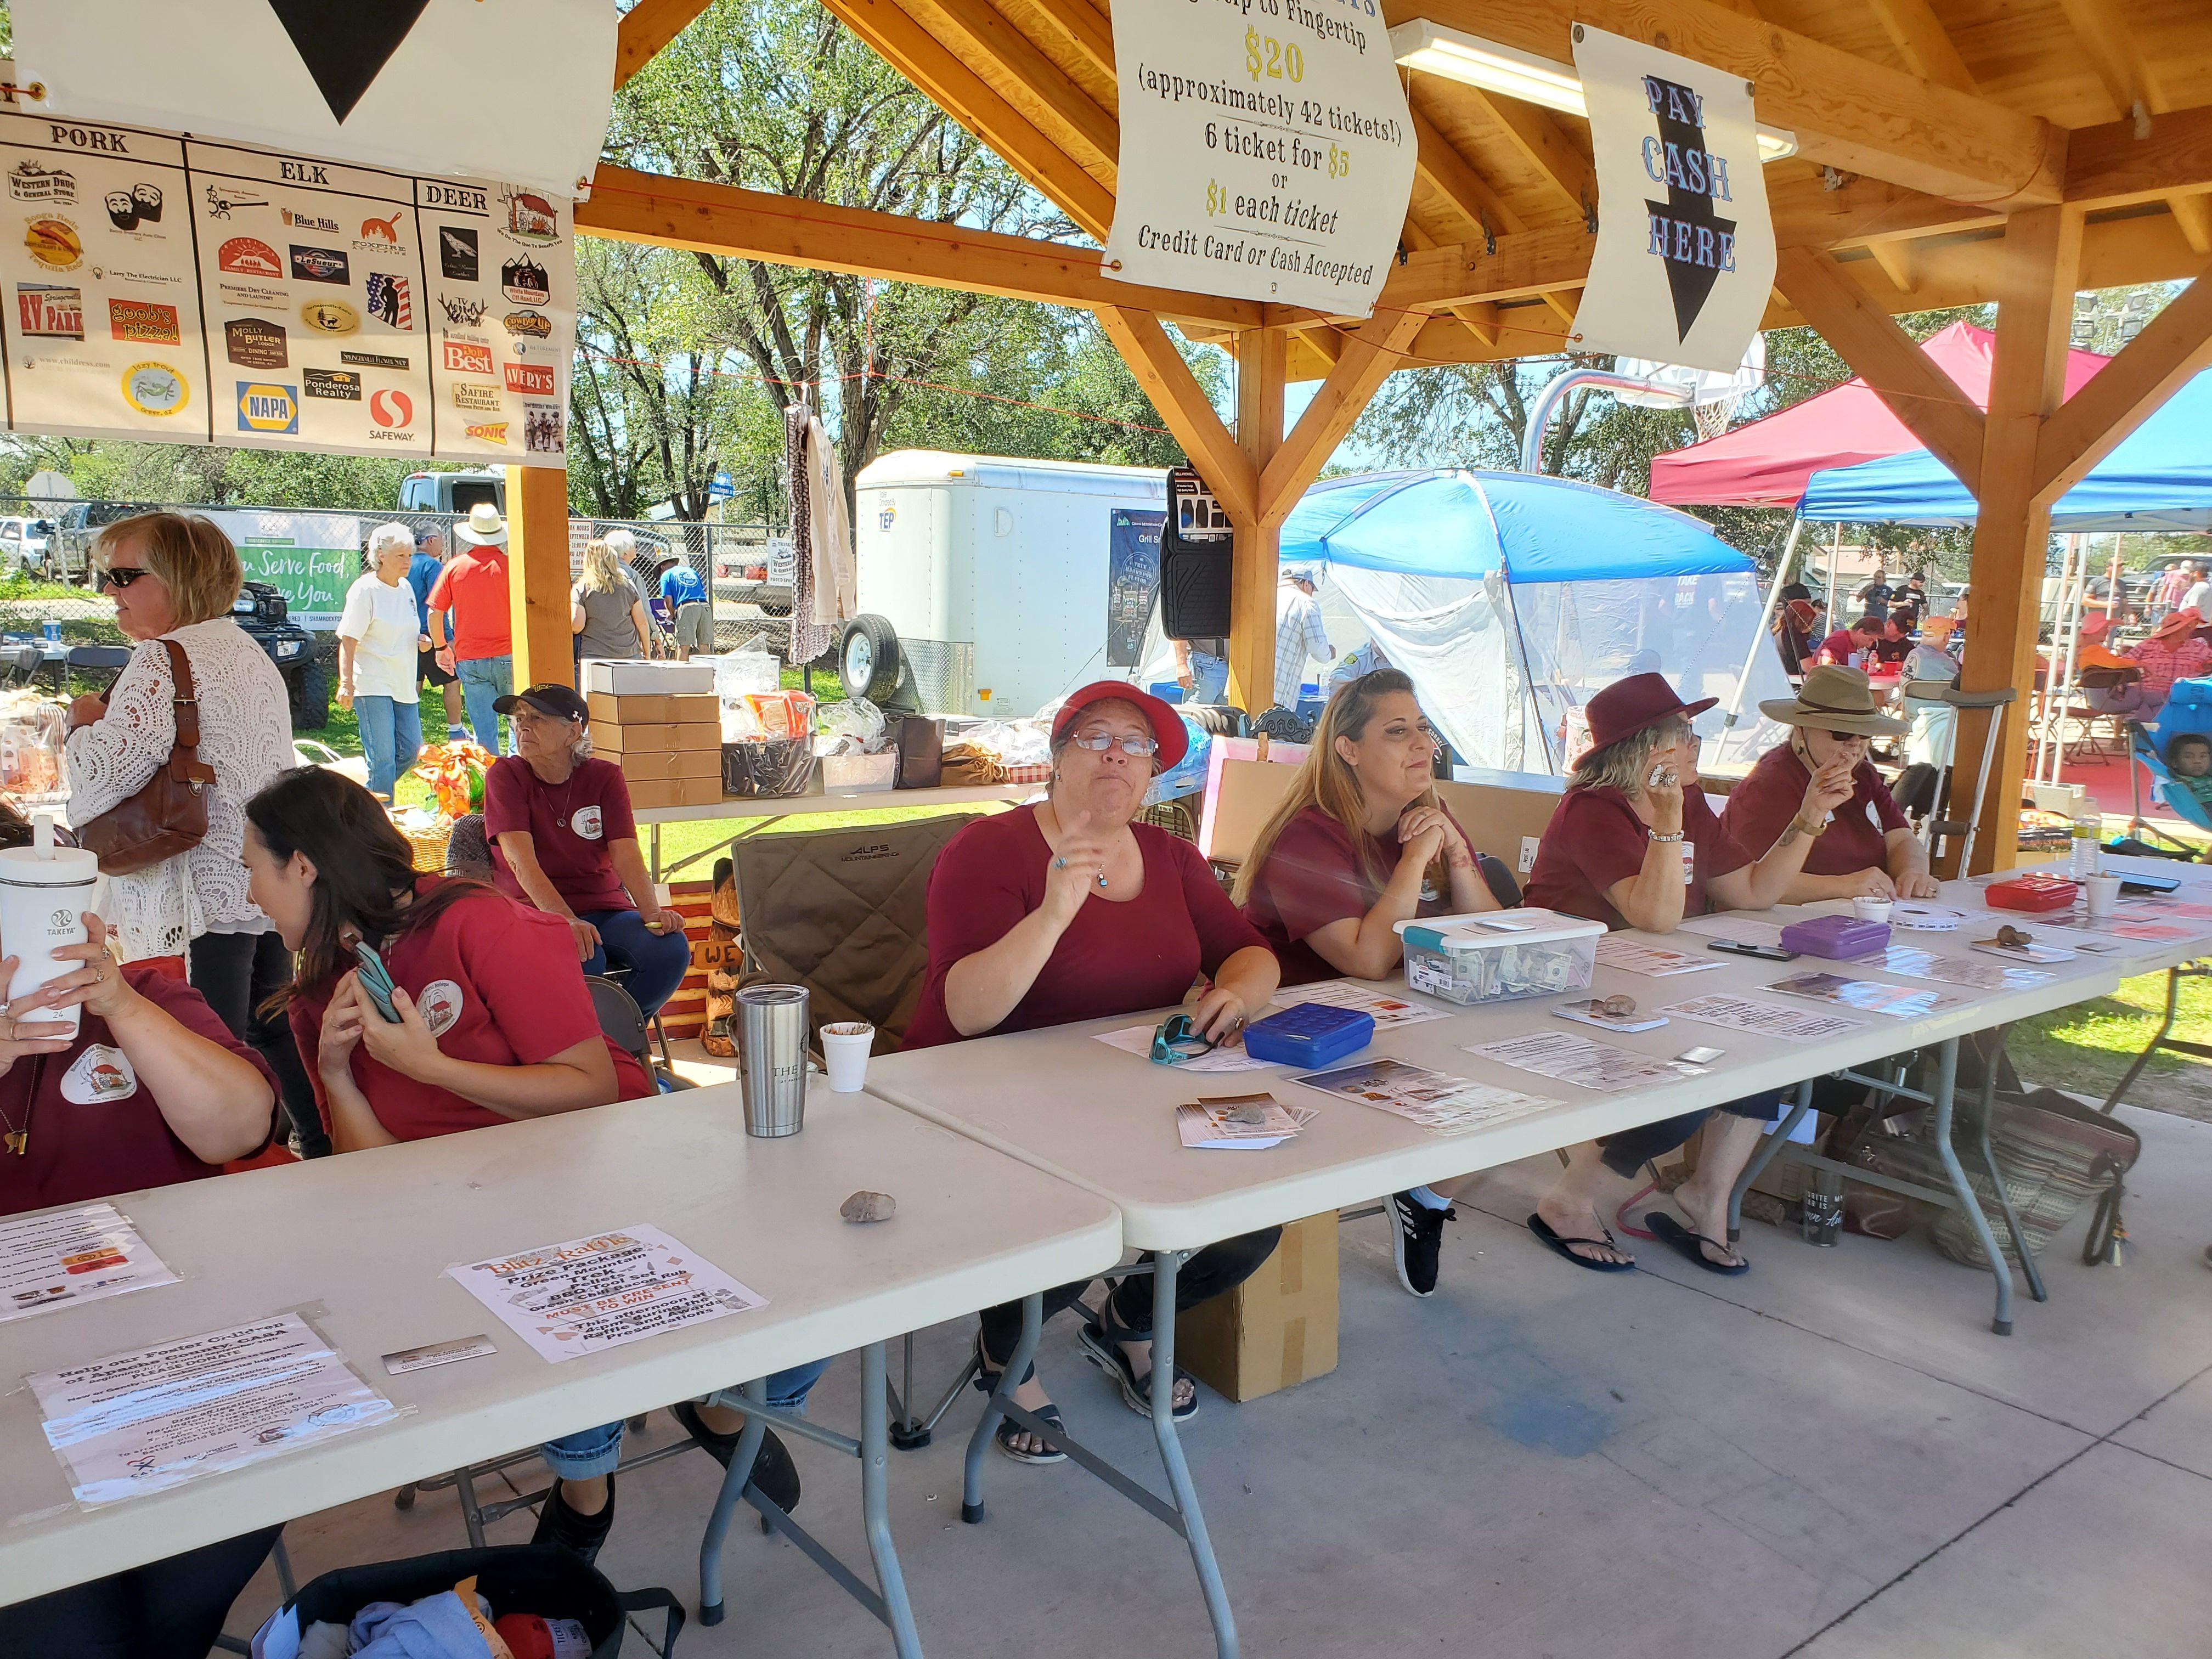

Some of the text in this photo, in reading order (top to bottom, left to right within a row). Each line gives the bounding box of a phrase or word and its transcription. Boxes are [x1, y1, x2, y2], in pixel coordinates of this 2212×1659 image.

[1287, 0, 1367, 54] Fingertip
[1245, 24, 1304, 83] $20
[1138, 62, 1402, 147] (approximately 42 tickets!)
[1641, 76, 1706, 129] PAY
[49, 125, 129, 154] PORK
[1205, 122, 1350, 180] 6 ticket for $5
[279, 161, 330, 185] ELK
[1272, 173, 1288, 189] or
[1640, 135, 1733, 203] CASH
[10, 176, 75, 190] WESTERN DRUG
[54, 189, 75, 198] STORE
[426, 185, 488, 211] DEER
[1206, 178, 1339, 234] $1 each ticket
[294, 213, 315, 227] Blue
[317, 217, 340, 231] Hills
[352, 240, 406, 251] FOXFIRE
[1138, 224, 1374, 286] Credit Card or Cash Accepted
[1647, 213, 1736, 273] HERE
[301, 256, 338, 268] LeSueur
[220, 283, 247, 292] PREMIERE
[261, 289, 289, 297] CLEANING
[250, 293, 273, 301] LAUNDRY
[18, 294, 83, 331] RV PARK
[111, 303, 171, 324] goob's
[123, 322, 178, 341] pizza!
[233, 327, 263, 337] MOLLY
[245, 334, 281, 345] BUTLER
[39, 357, 110, 369] www.childress.com
[445, 346, 492, 373] Best
[305, 379, 360, 392] Ponderosa
[461, 383, 494, 398] SAFIRE
[506, 368, 554, 390] AVERY'S
[315, 387, 351, 399] Realty
[455, 393, 500, 407] RESTAURANT
[250, 396, 288, 419] NAPA
[466, 425, 506, 439] SONIC
[879, 512, 894, 529] TEP
[1138, 534, 1152, 544] Grill
[258, 550, 349, 579] Serve Food,
[297, 582, 338, 611] You.
[850, 844, 889, 854] ALPS
[47, 927, 75, 935] TAKEYA
[771, 1064, 798, 1077] THE
[488, 1236, 631, 1274] Blitz Raffle
[507, 1246, 644, 1284] Prize Package
[520, 1252, 647, 1289] Green Mountain
[566, 1268, 617, 1283] Trek
[570, 1272, 626, 1290] Pellets
[529, 1269, 687, 1312] Green Bacon Rub
[550, 1270, 657, 1301] BBQ Tool Set
[545, 1278, 691, 1319] MUST BE PRESENT
[597, 1293, 654, 1311] TO WIN
[575, 1318, 610, 1329] This
[614, 1296, 687, 1319] afternoon
[583, 1299, 724, 1340] Raffle and Awards
[585, 1297, 709, 1333] 4:pm during the
[606, 1308, 714, 1340] Presentations
[57, 1322, 286, 1378] Help our Foster Children
[65, 1329, 289, 1385] of Apache County, CASA
[89, 1341, 257, 1384] Beginning July until September
[132, 1350, 242, 1379] PLEASE DONATE
